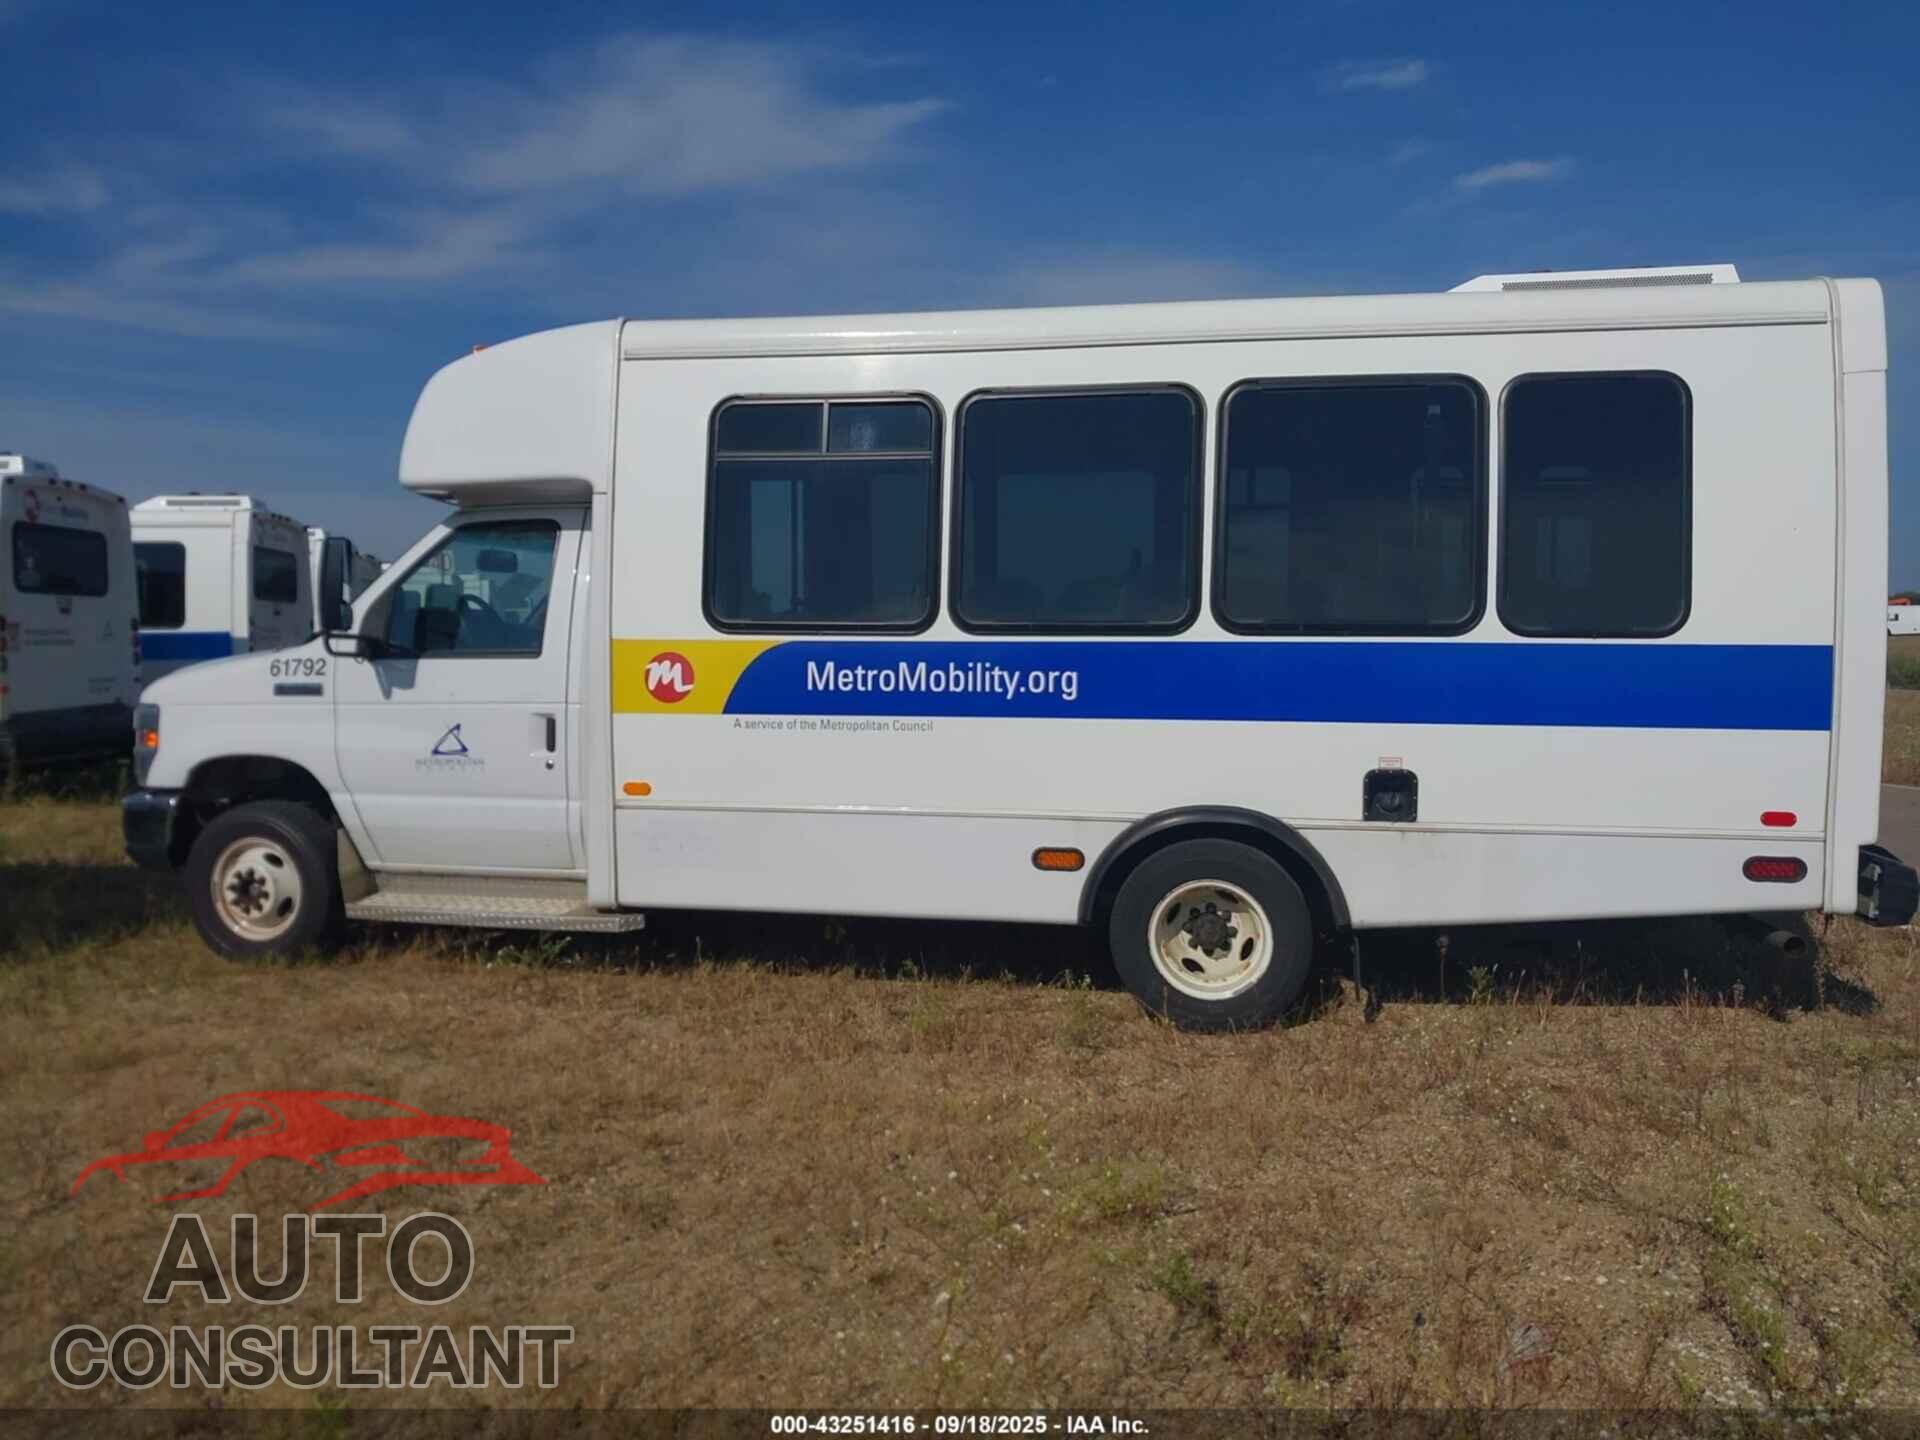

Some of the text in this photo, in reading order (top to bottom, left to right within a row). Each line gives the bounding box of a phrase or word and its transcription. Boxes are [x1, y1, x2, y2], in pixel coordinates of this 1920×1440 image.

[270, 658, 327, 677] 61792
[806, 660, 1079, 700] MetroMobility.org
[733, 717, 935, 733] A service of the Metropolitan Council
